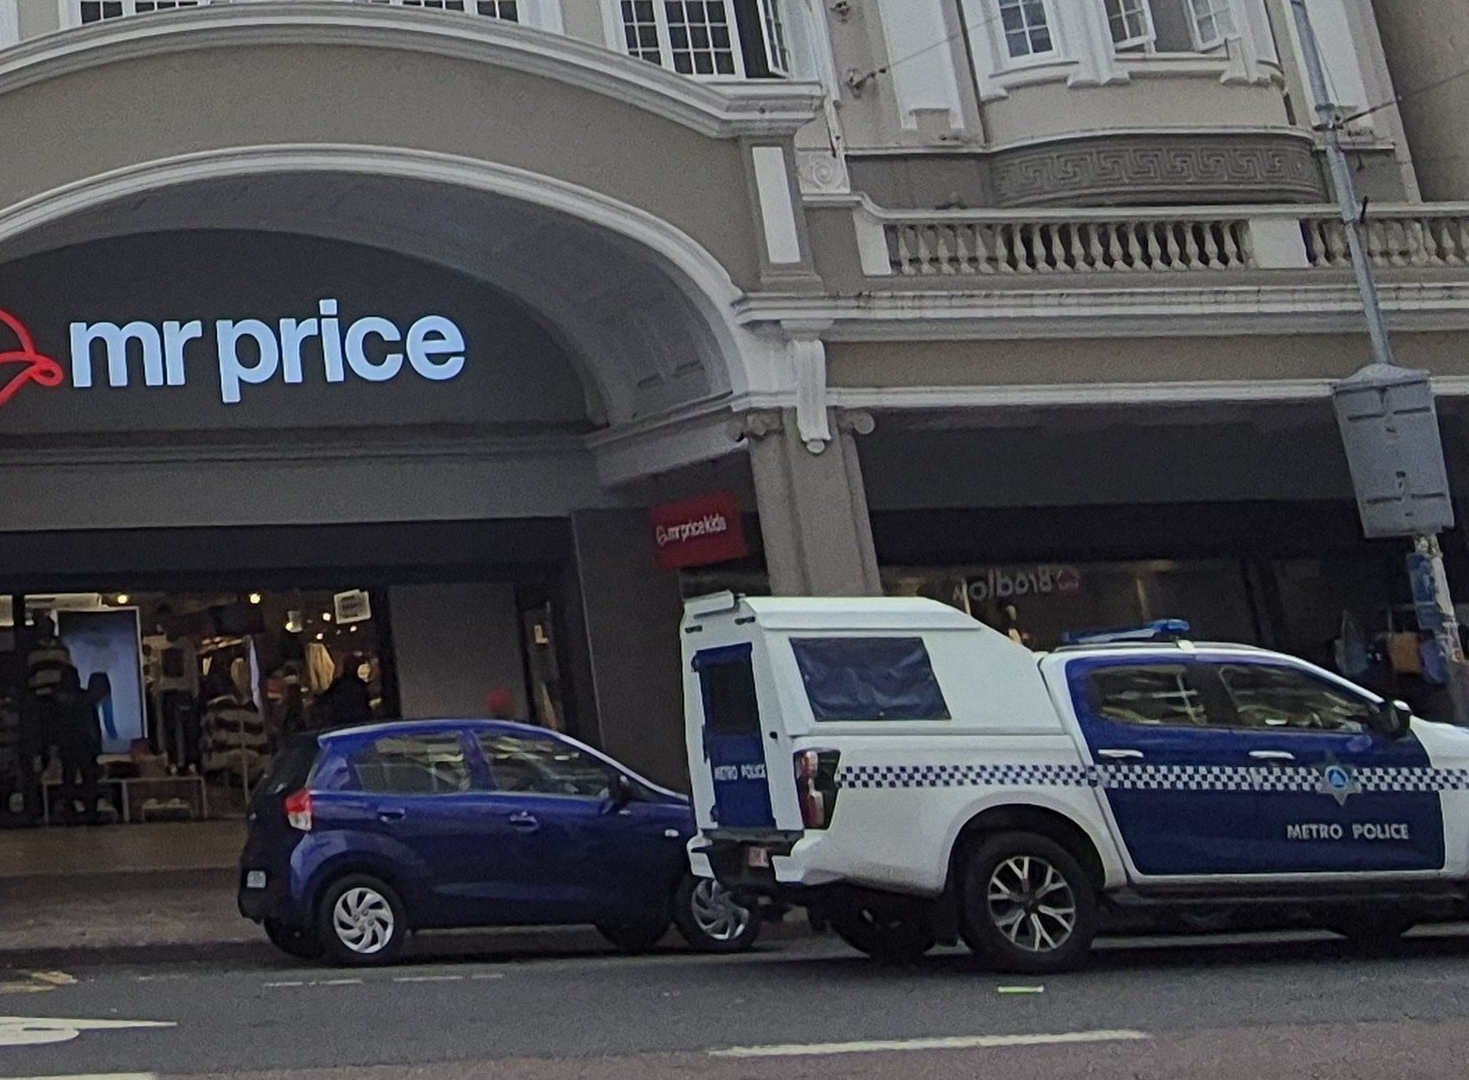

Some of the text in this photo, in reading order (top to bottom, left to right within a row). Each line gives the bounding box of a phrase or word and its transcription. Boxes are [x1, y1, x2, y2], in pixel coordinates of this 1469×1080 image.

[69, 298, 466, 404] mr price
[714, 764, 766, 780] METRO POLICE
[1286, 823, 1409, 840] METRO POLICE
